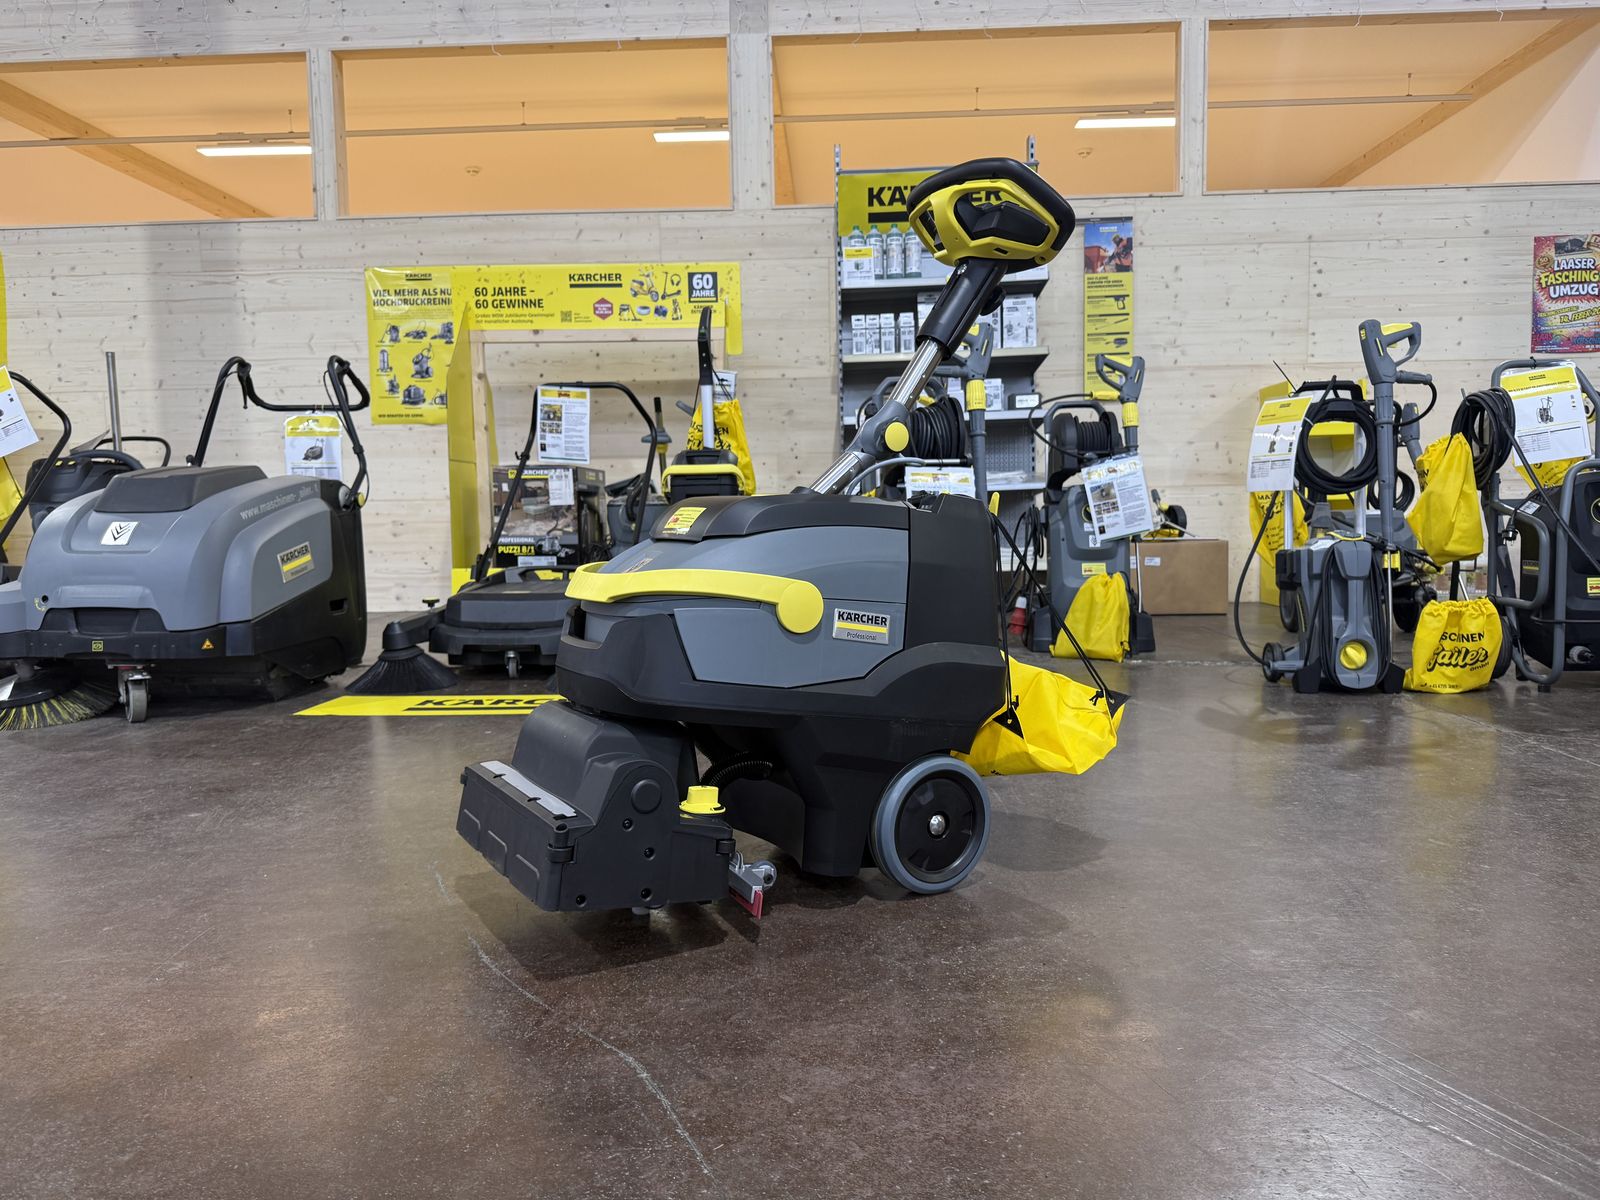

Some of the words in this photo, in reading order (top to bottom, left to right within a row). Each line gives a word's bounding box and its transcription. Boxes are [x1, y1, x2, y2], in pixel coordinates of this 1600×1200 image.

[868, 186, 1003, 207] KÄER
[1554, 258, 1595, 271] LAASER
[569, 273, 622, 282] KÄRCHER
[692, 274, 713, 289] 60
[1540, 270, 1600, 288] FASCHING
[373, 289, 392, 297] VIEL
[394, 288, 419, 297] MEHR
[421, 288, 438, 296] ALS
[440, 288, 452, 296] NU
[474, 287, 488, 297] 60
[491, 287, 526, 297] JAHRE
[691, 289, 715, 298] JAHRE
[1549, 283, 1599, 298] UMZUG
[475, 299, 489, 309] 60
[491, 298, 544, 309] GEWINNE
[498, 545, 521, 554] PUZZI
[521, 545, 535, 554] 8/1
[838, 611, 888, 626] KÄRCHER
[847, 632, 877, 641] Professional
